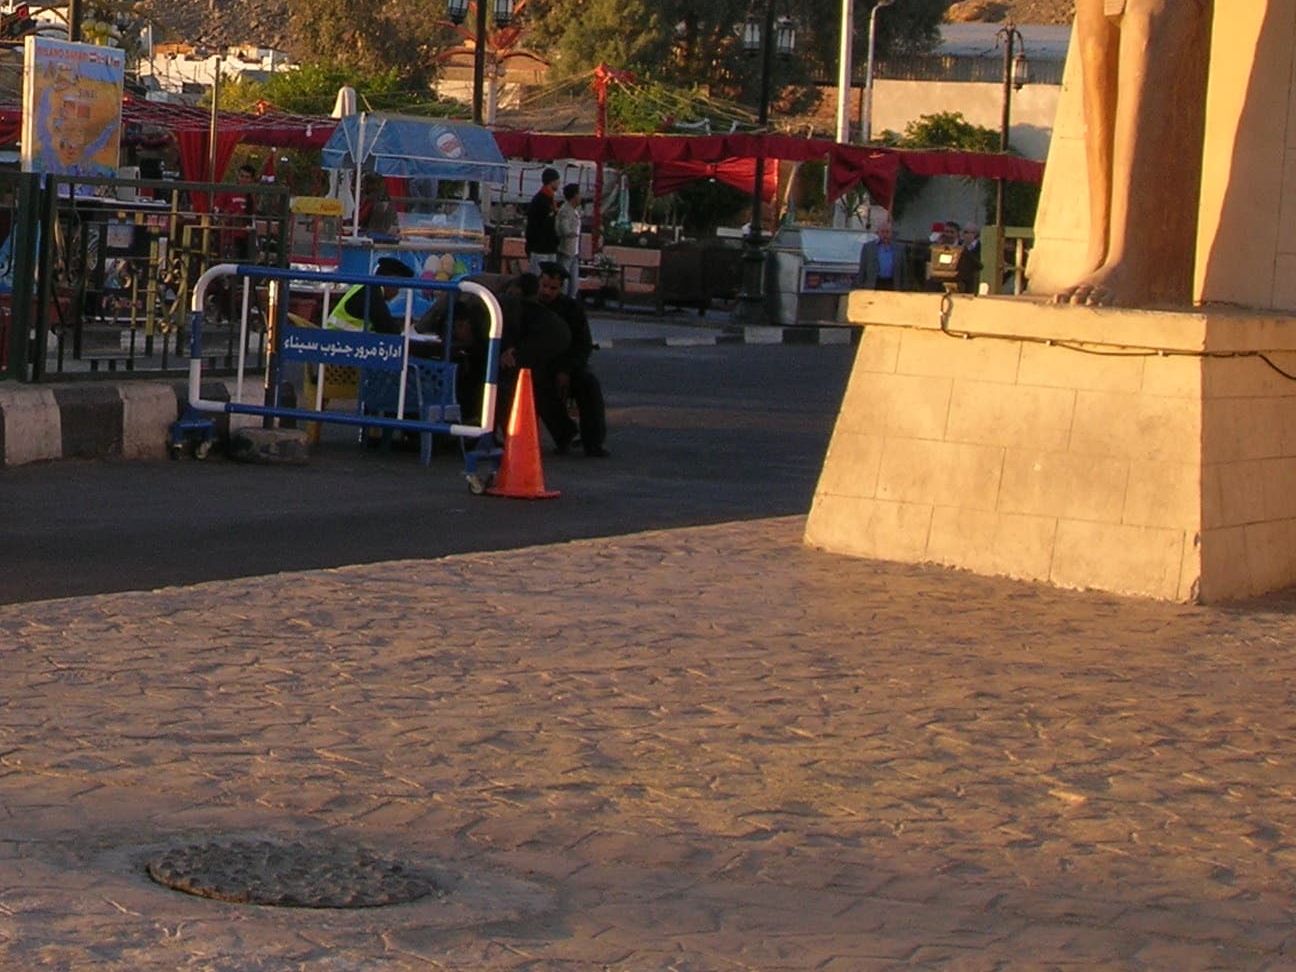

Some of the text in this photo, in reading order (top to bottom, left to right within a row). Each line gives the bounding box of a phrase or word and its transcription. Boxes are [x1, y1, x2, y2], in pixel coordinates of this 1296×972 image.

[283, 335, 319, 354] سيناء
[319, 341, 353, 358] جنوب
[352, 344, 377, 360] مرور
